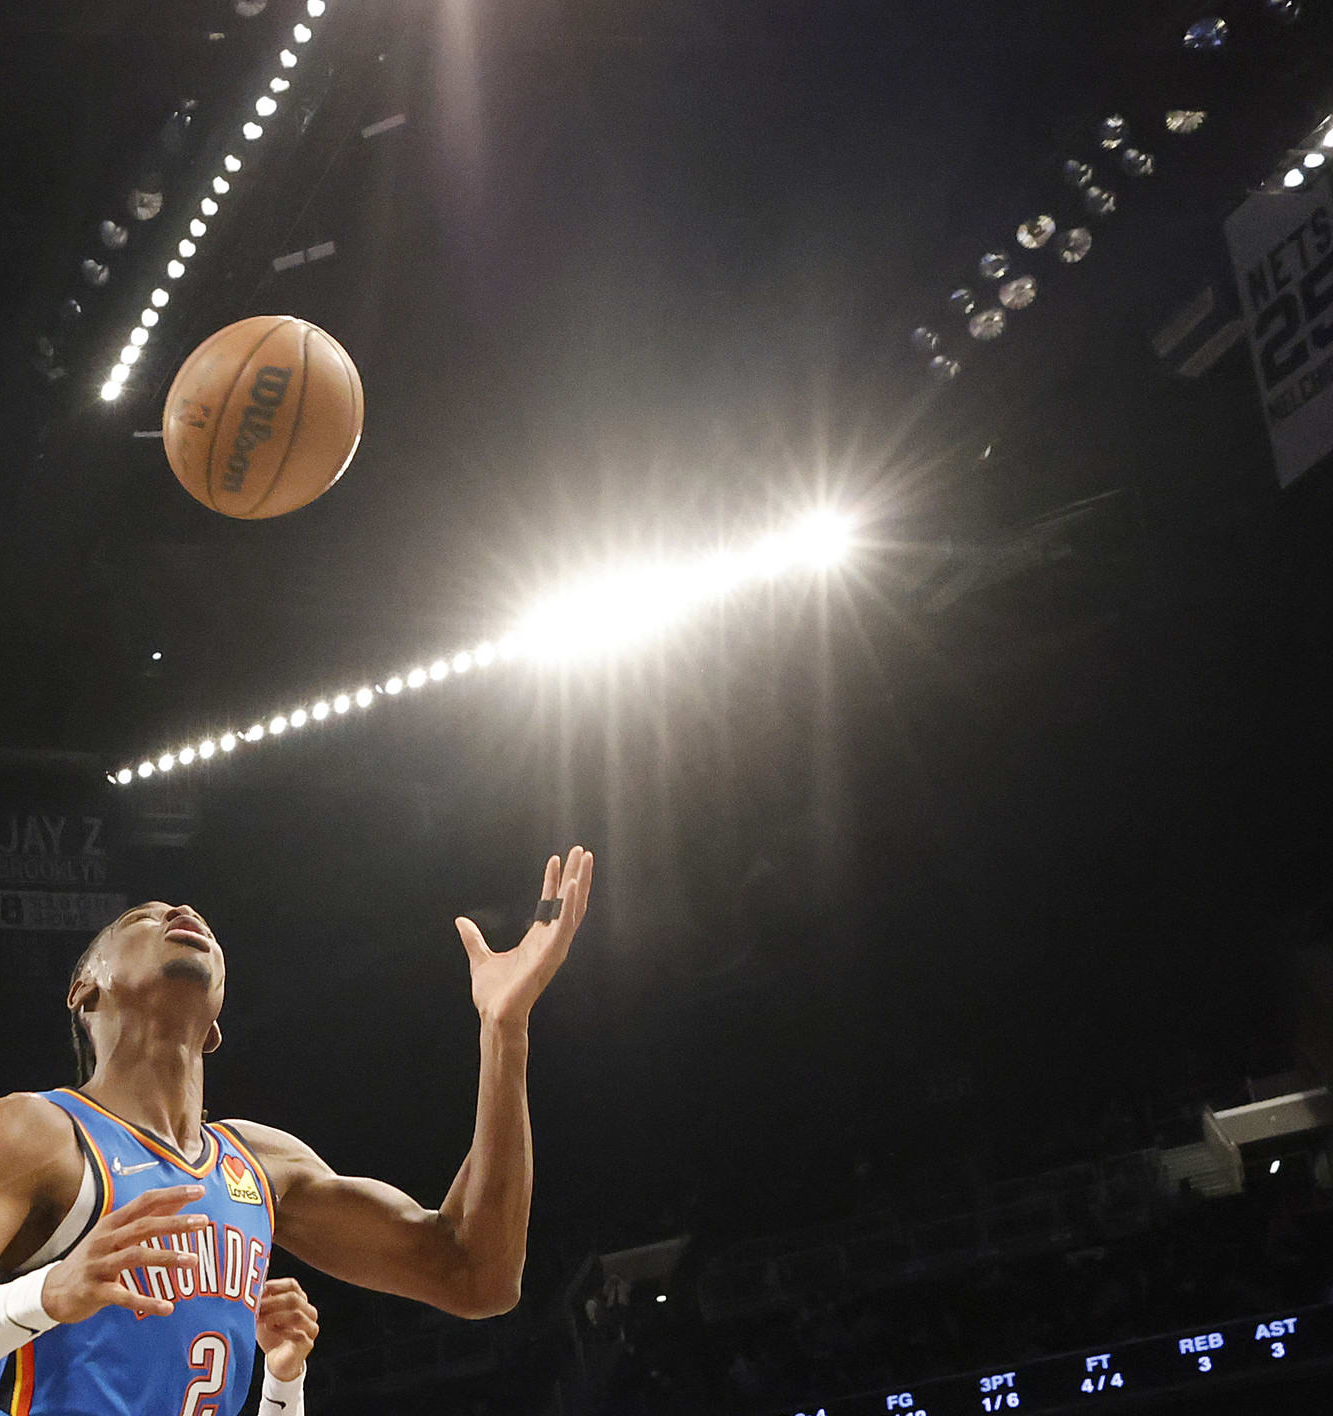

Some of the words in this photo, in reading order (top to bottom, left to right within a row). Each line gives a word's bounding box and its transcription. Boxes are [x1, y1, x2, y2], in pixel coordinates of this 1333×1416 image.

[1254, 1317, 1298, 1341] AST
[1178, 1332, 1224, 1355] REB
[1271, 1341, 1285, 1359] 3
[1085, 1353, 1111, 1372] FT
[1198, 1356, 1212, 1372] 3
[979, 1372, 1016, 1393] 3PT
[886, 1392, 913, 1410] FG
